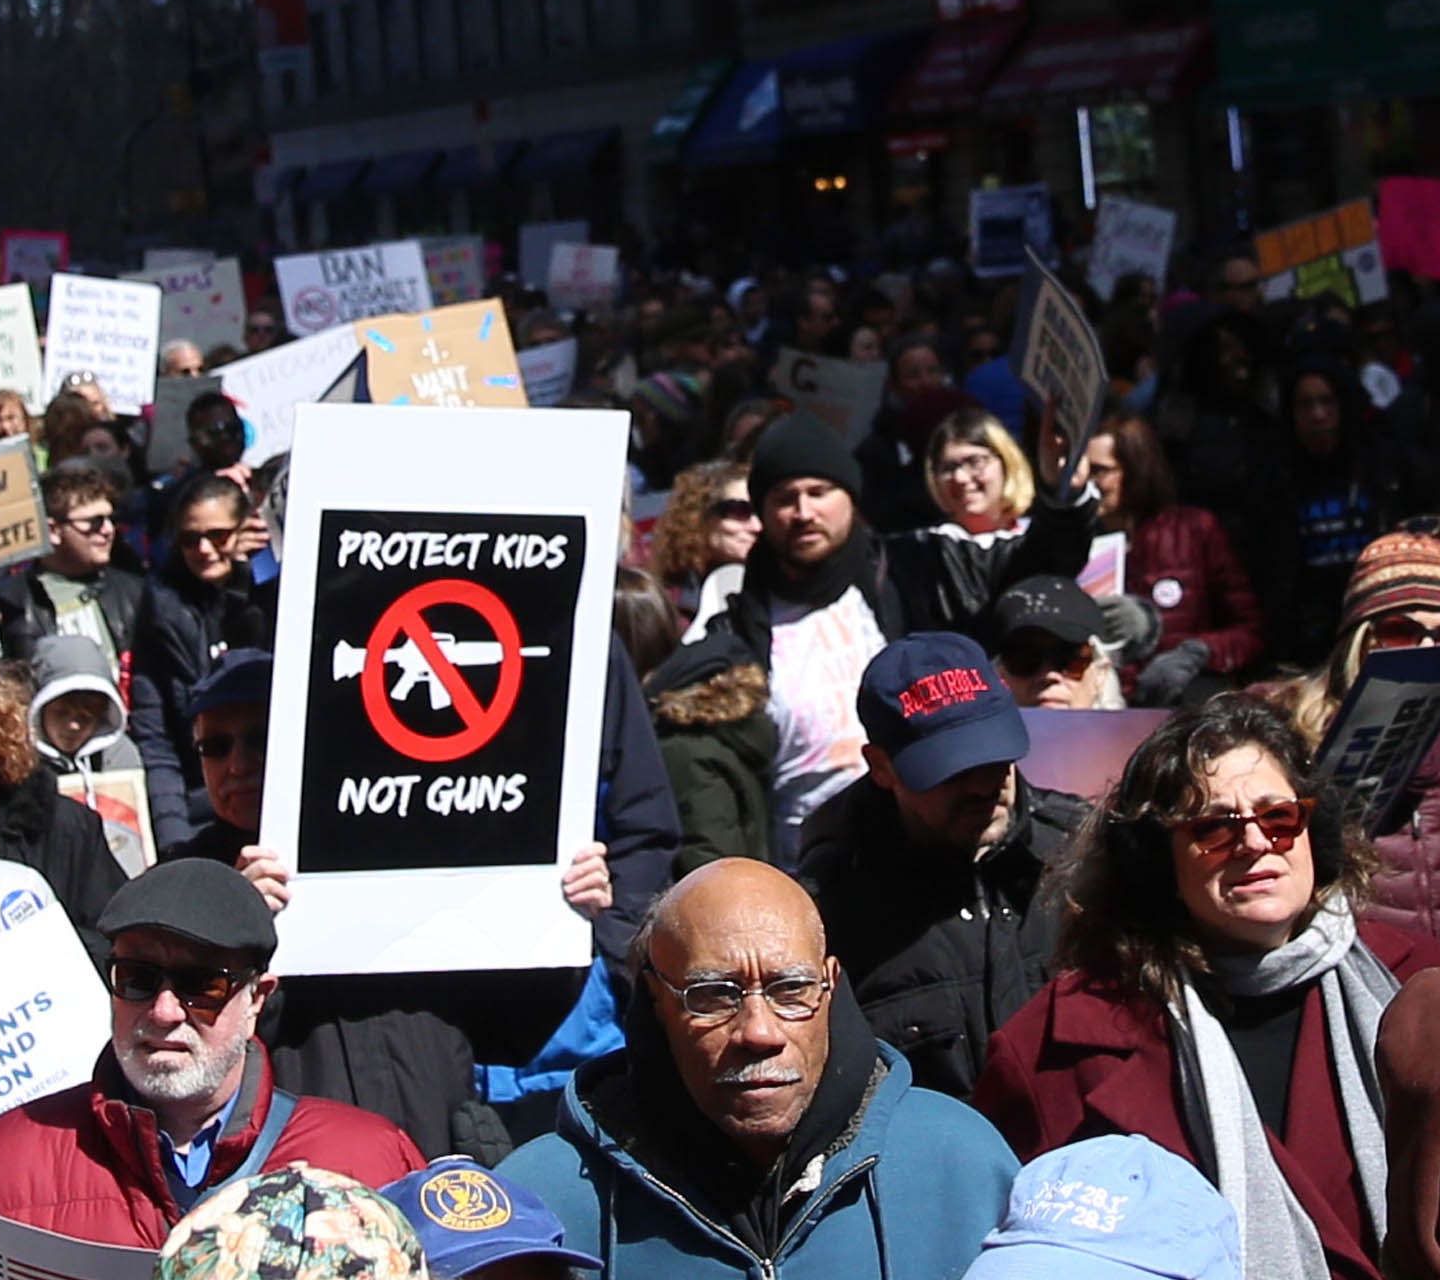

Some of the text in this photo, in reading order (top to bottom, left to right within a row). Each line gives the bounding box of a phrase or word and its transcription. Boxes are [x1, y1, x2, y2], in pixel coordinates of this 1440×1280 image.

[319, 247, 385, 286] BAN
[409, 365, 471, 396] WANT
[338, 528, 570, 570] PROTECT KIDS
[942, 667, 991, 695] ROLL
[337, 772, 527, 815] NOT GUNS
